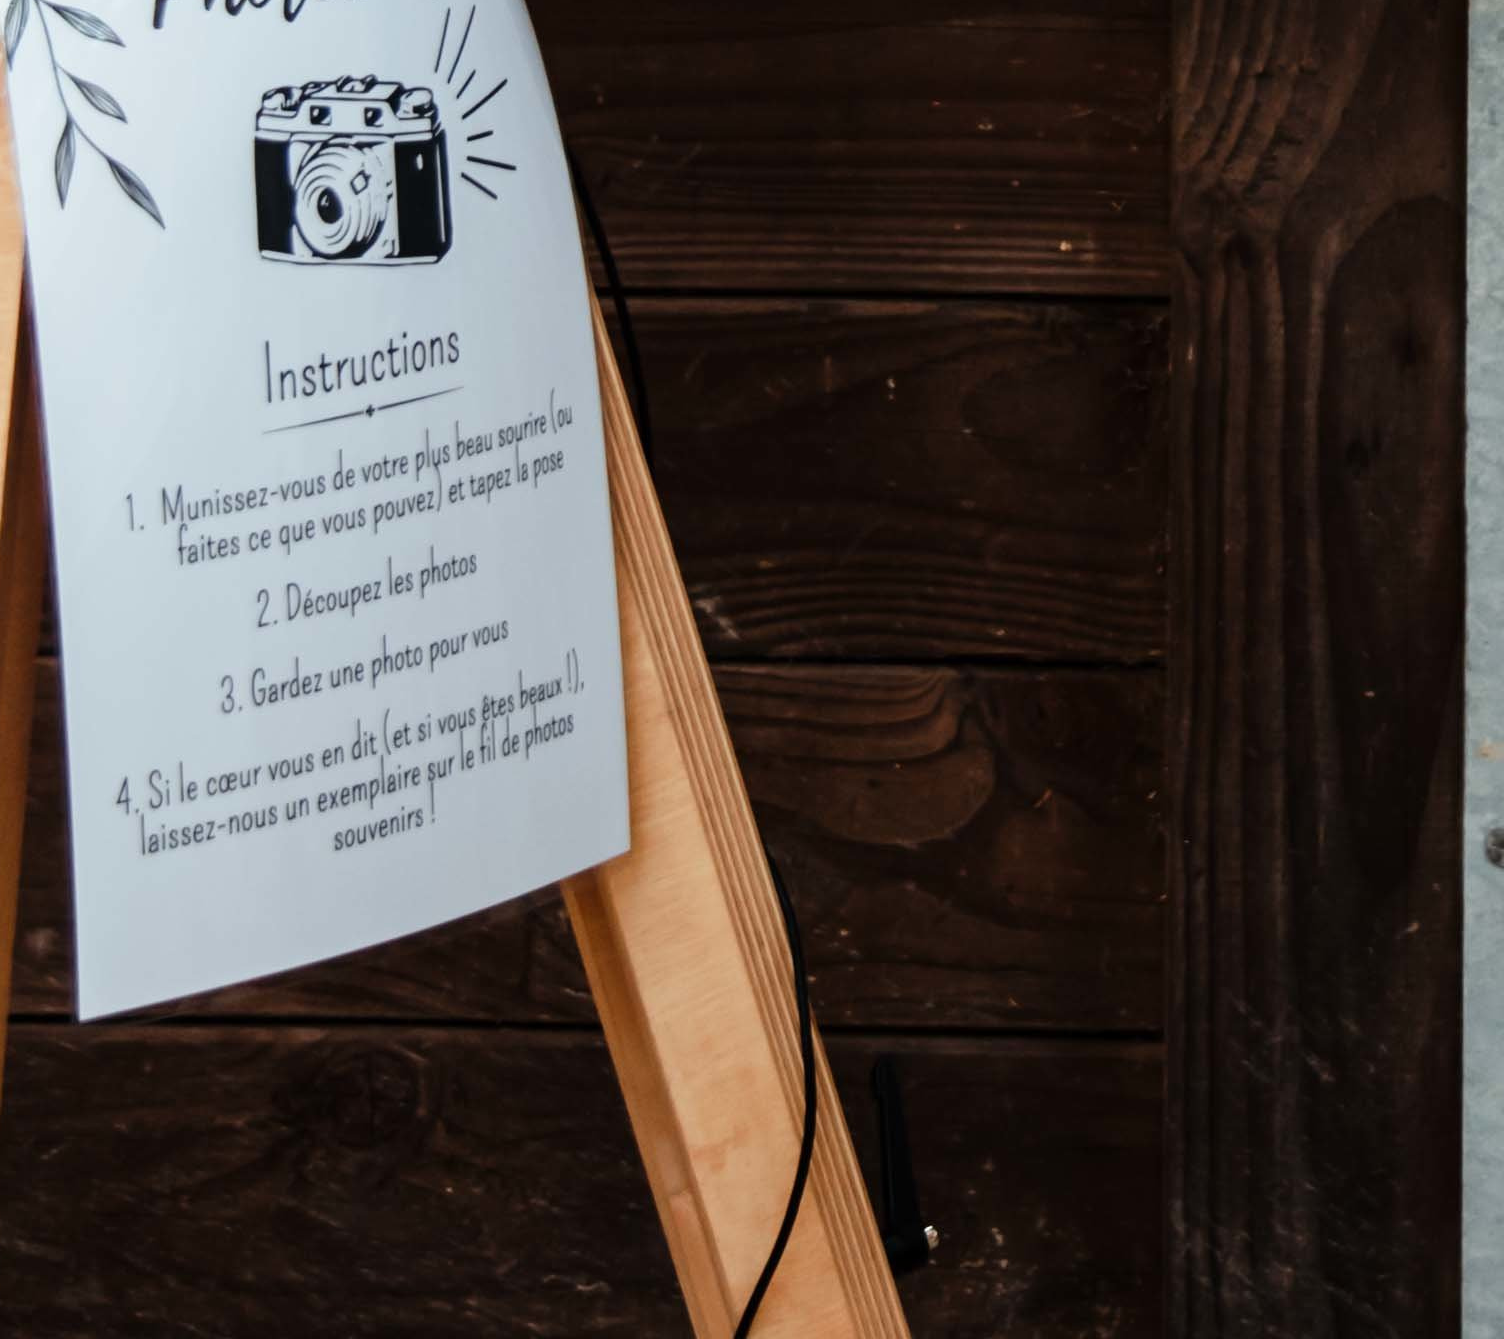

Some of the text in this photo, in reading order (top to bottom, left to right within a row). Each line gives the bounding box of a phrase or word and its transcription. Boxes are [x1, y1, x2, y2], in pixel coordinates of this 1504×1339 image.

[265, 331, 460, 403] Instructions
[126, 387, 573, 531] 1. Munissez-vous de votre plus beau sourire (ou
[178, 442, 564, 565] faites ce que vous pouvez) et tapez la pose
[257, 545, 477, 628] 2. Découpez les photos
[221, 620, 509, 714] 3. Gardez une photo pour vous
[116, 777, 139, 815] 4.
[149, 769, 170, 809] Si
[180, 761, 197, 803] le
[207, 765, 261, 796] cœur
[268, 753, 314, 781] vous
[322, 745, 344, 768] en
[351, 718, 377, 761] dit
[384, 708, 411, 755] (et
[418, 713, 431, 742] si
[437, 707, 476, 735] vous
[482, 694, 514, 722] êtes
[520, 669, 562, 709] beaux
[141, 704, 574, 855] laissez-nous un exemplaire sur le fil de photos
[334, 781, 435, 851] souvenirs !
